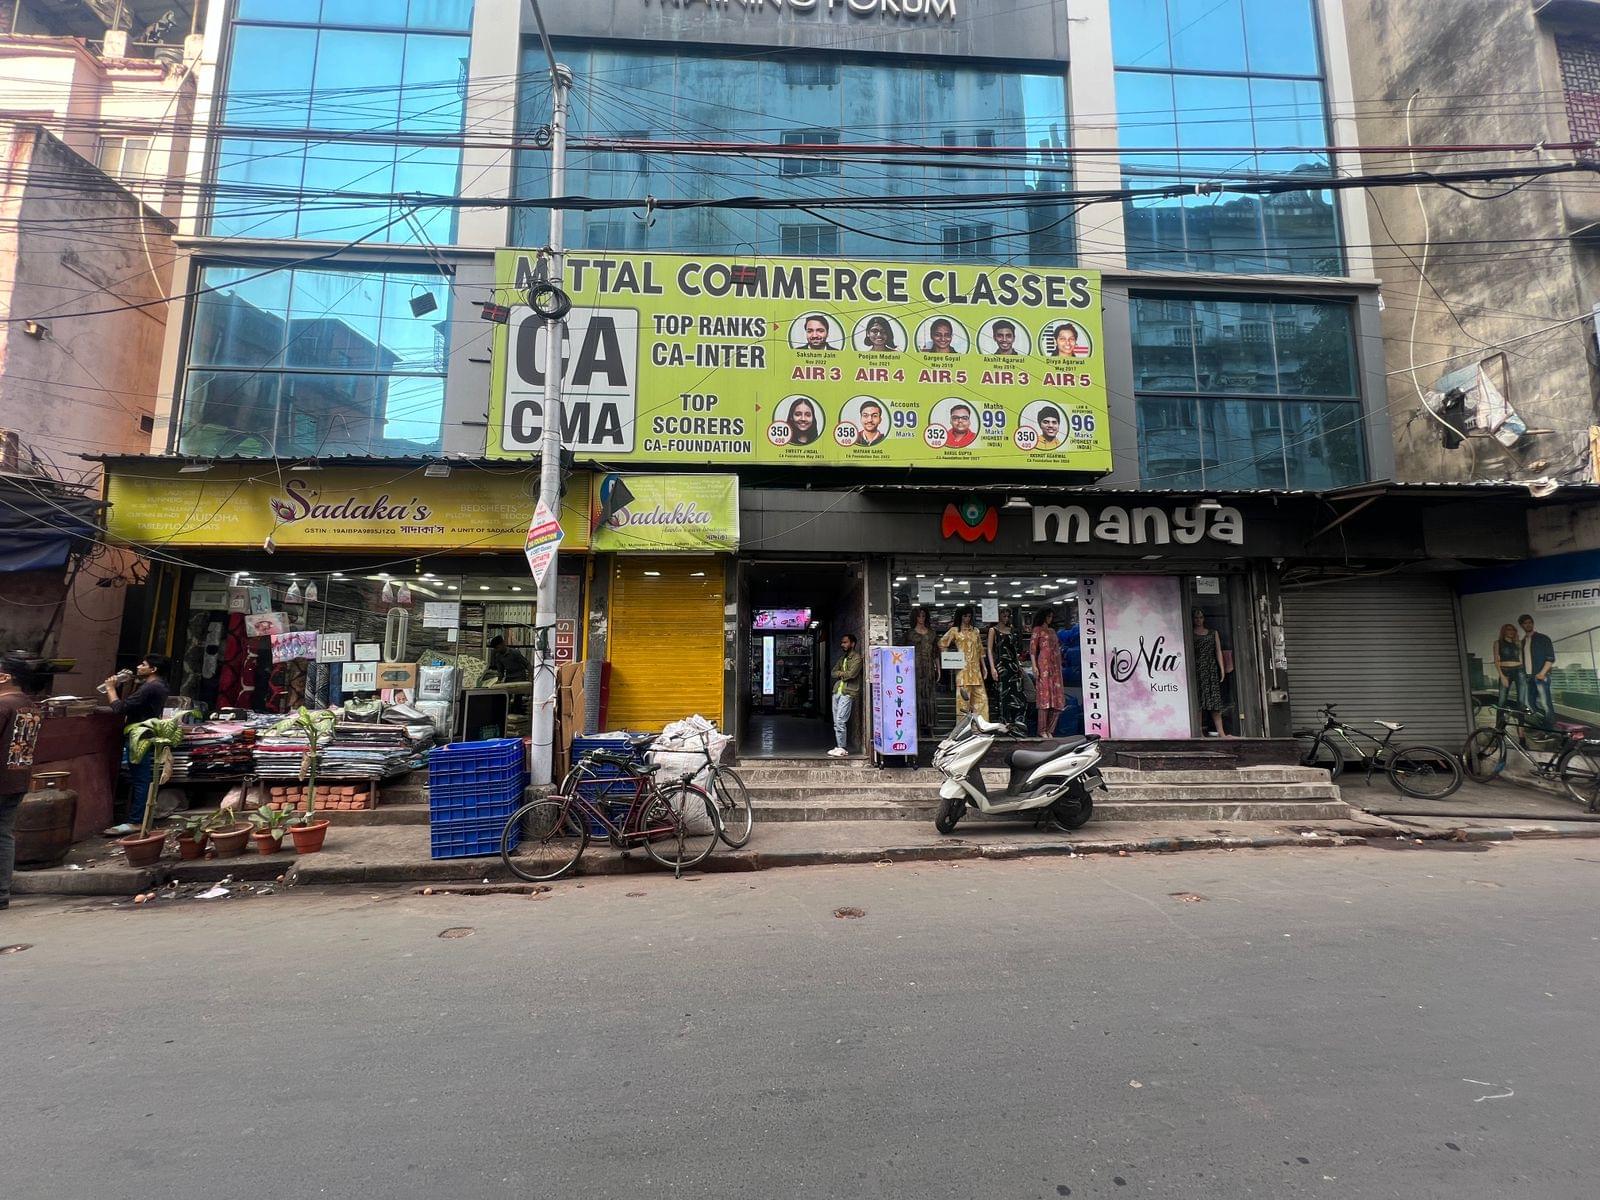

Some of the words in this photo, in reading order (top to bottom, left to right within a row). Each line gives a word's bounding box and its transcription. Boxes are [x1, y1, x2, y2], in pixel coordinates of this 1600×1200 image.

[514, 256, 663, 295] MTTAL
[678, 263, 908, 302] COMMERCE
[922, 270, 1091, 309] CLASSES
[653, 315, 693, 335] TOP
[699, 317, 765, 337] RANKS
[516, 314, 628, 387] CA
[652, 343, 765, 369] CA-INTER
[791, 366, 825, 380] AIR
[829, 367, 842, 380] 3
[855, 368, 889, 382] AIR
[893, 369, 905, 382] 4
[918, 370, 952, 383] AIR
[956, 371, 968, 384] 5
[981, 371, 1014, 385] AIR
[1018, 372, 1030, 385] 3
[1043, 373, 1075, 386] AIR
[1079, 374, 1091, 387] 5
[680, 394, 718, 412] TOP
[511, 400, 625, 445] CMA
[653, 417, 744, 436] SCORERS
[893, 410, 917, 428] 99
[982, 410, 1006, 428] 99
[1071, 414, 1095, 432] 96
[770, 426, 789, 437] 350
[837, 427, 855, 438] 358
[927, 429, 945, 440] 352
[1017, 431, 1035, 442] 350
[644, 439, 751, 453] CA-FOUNDATION
[285, 479, 431, 521] Sadaka's
[460, 504, 517, 512] BEDSHEETS
[1032, 504, 1244, 545] manya
[1537, 588, 1600, 603] HOFFMEN
[1083, 578, 1097, 655] DIVANSHI
[1110, 635, 1181, 683] Nia
[1088, 661, 1102, 730] FASHION
[1150, 683, 1179, 692] Kurtis
